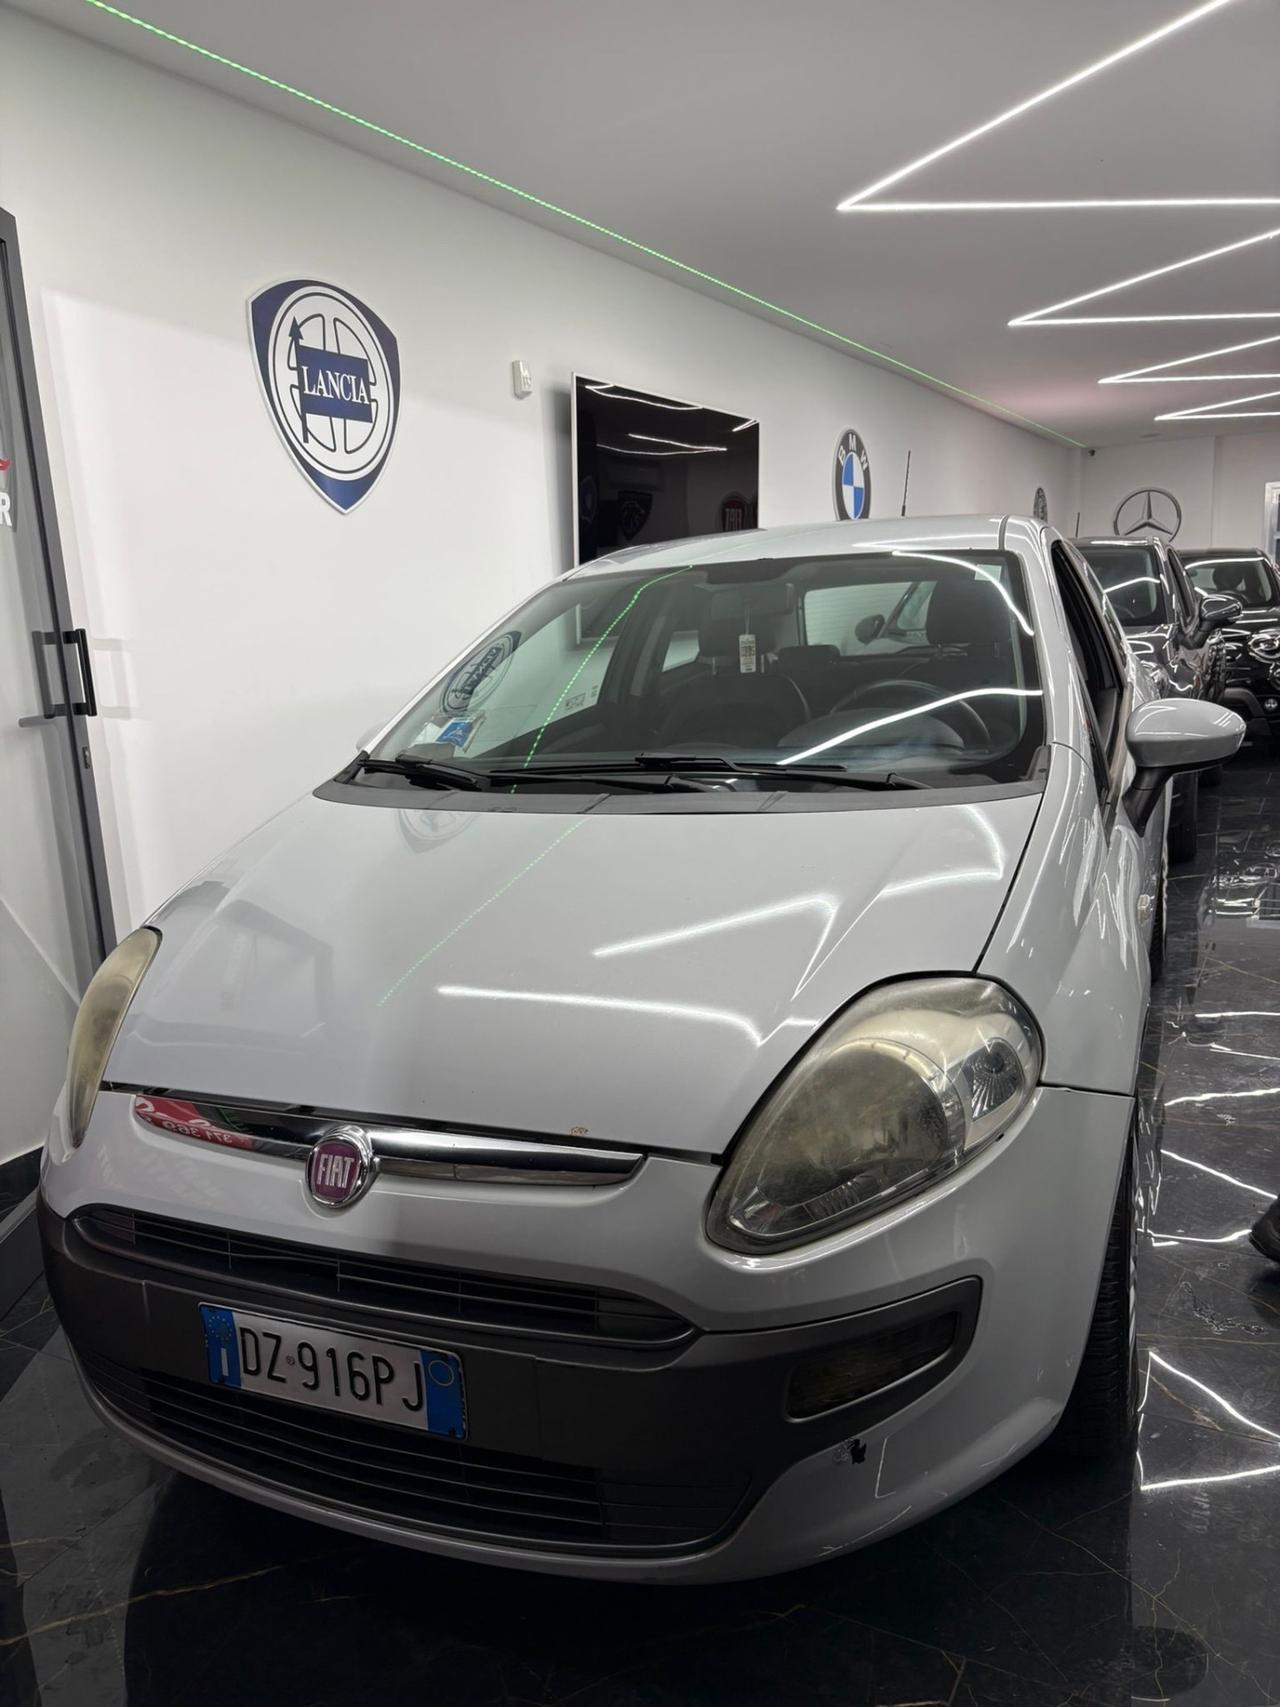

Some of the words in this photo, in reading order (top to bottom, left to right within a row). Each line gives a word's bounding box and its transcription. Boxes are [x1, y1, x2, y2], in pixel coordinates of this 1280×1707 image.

[302, 365, 370, 404] LANCIA
[839, 433, 869, 471] BMW
[317, 1153, 355, 1189] FIAT
